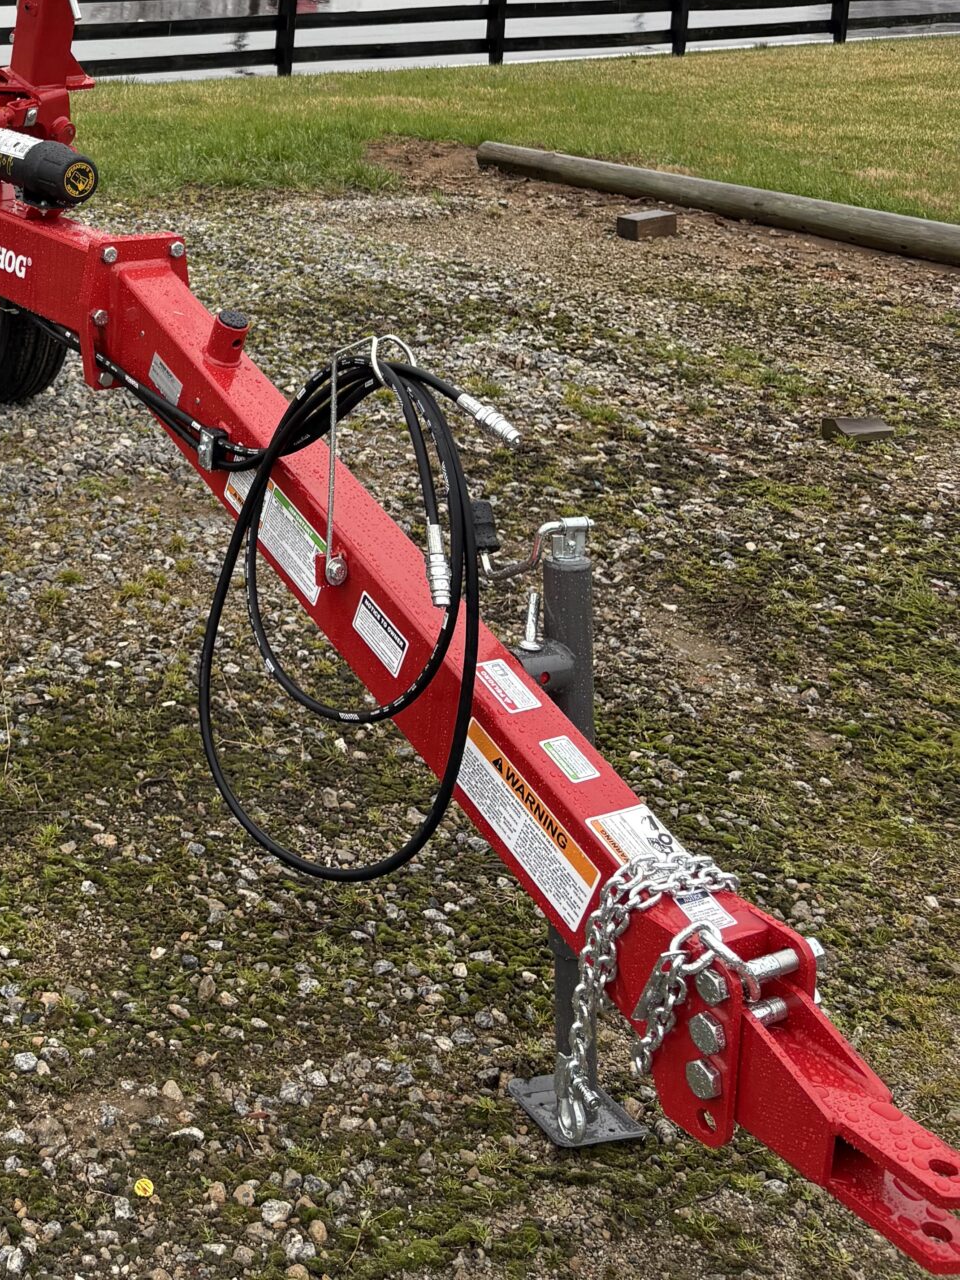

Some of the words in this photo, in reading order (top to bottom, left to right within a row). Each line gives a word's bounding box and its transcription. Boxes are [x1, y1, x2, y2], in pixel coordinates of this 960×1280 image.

[288, 506, 314, 536] IMPORTANT
[364, 598, 381, 621] NOTICE
[380, 617, 388, 628] TO
[387, 627, 405, 648] OWNER
[505, 766, 568, 850] WARNING
